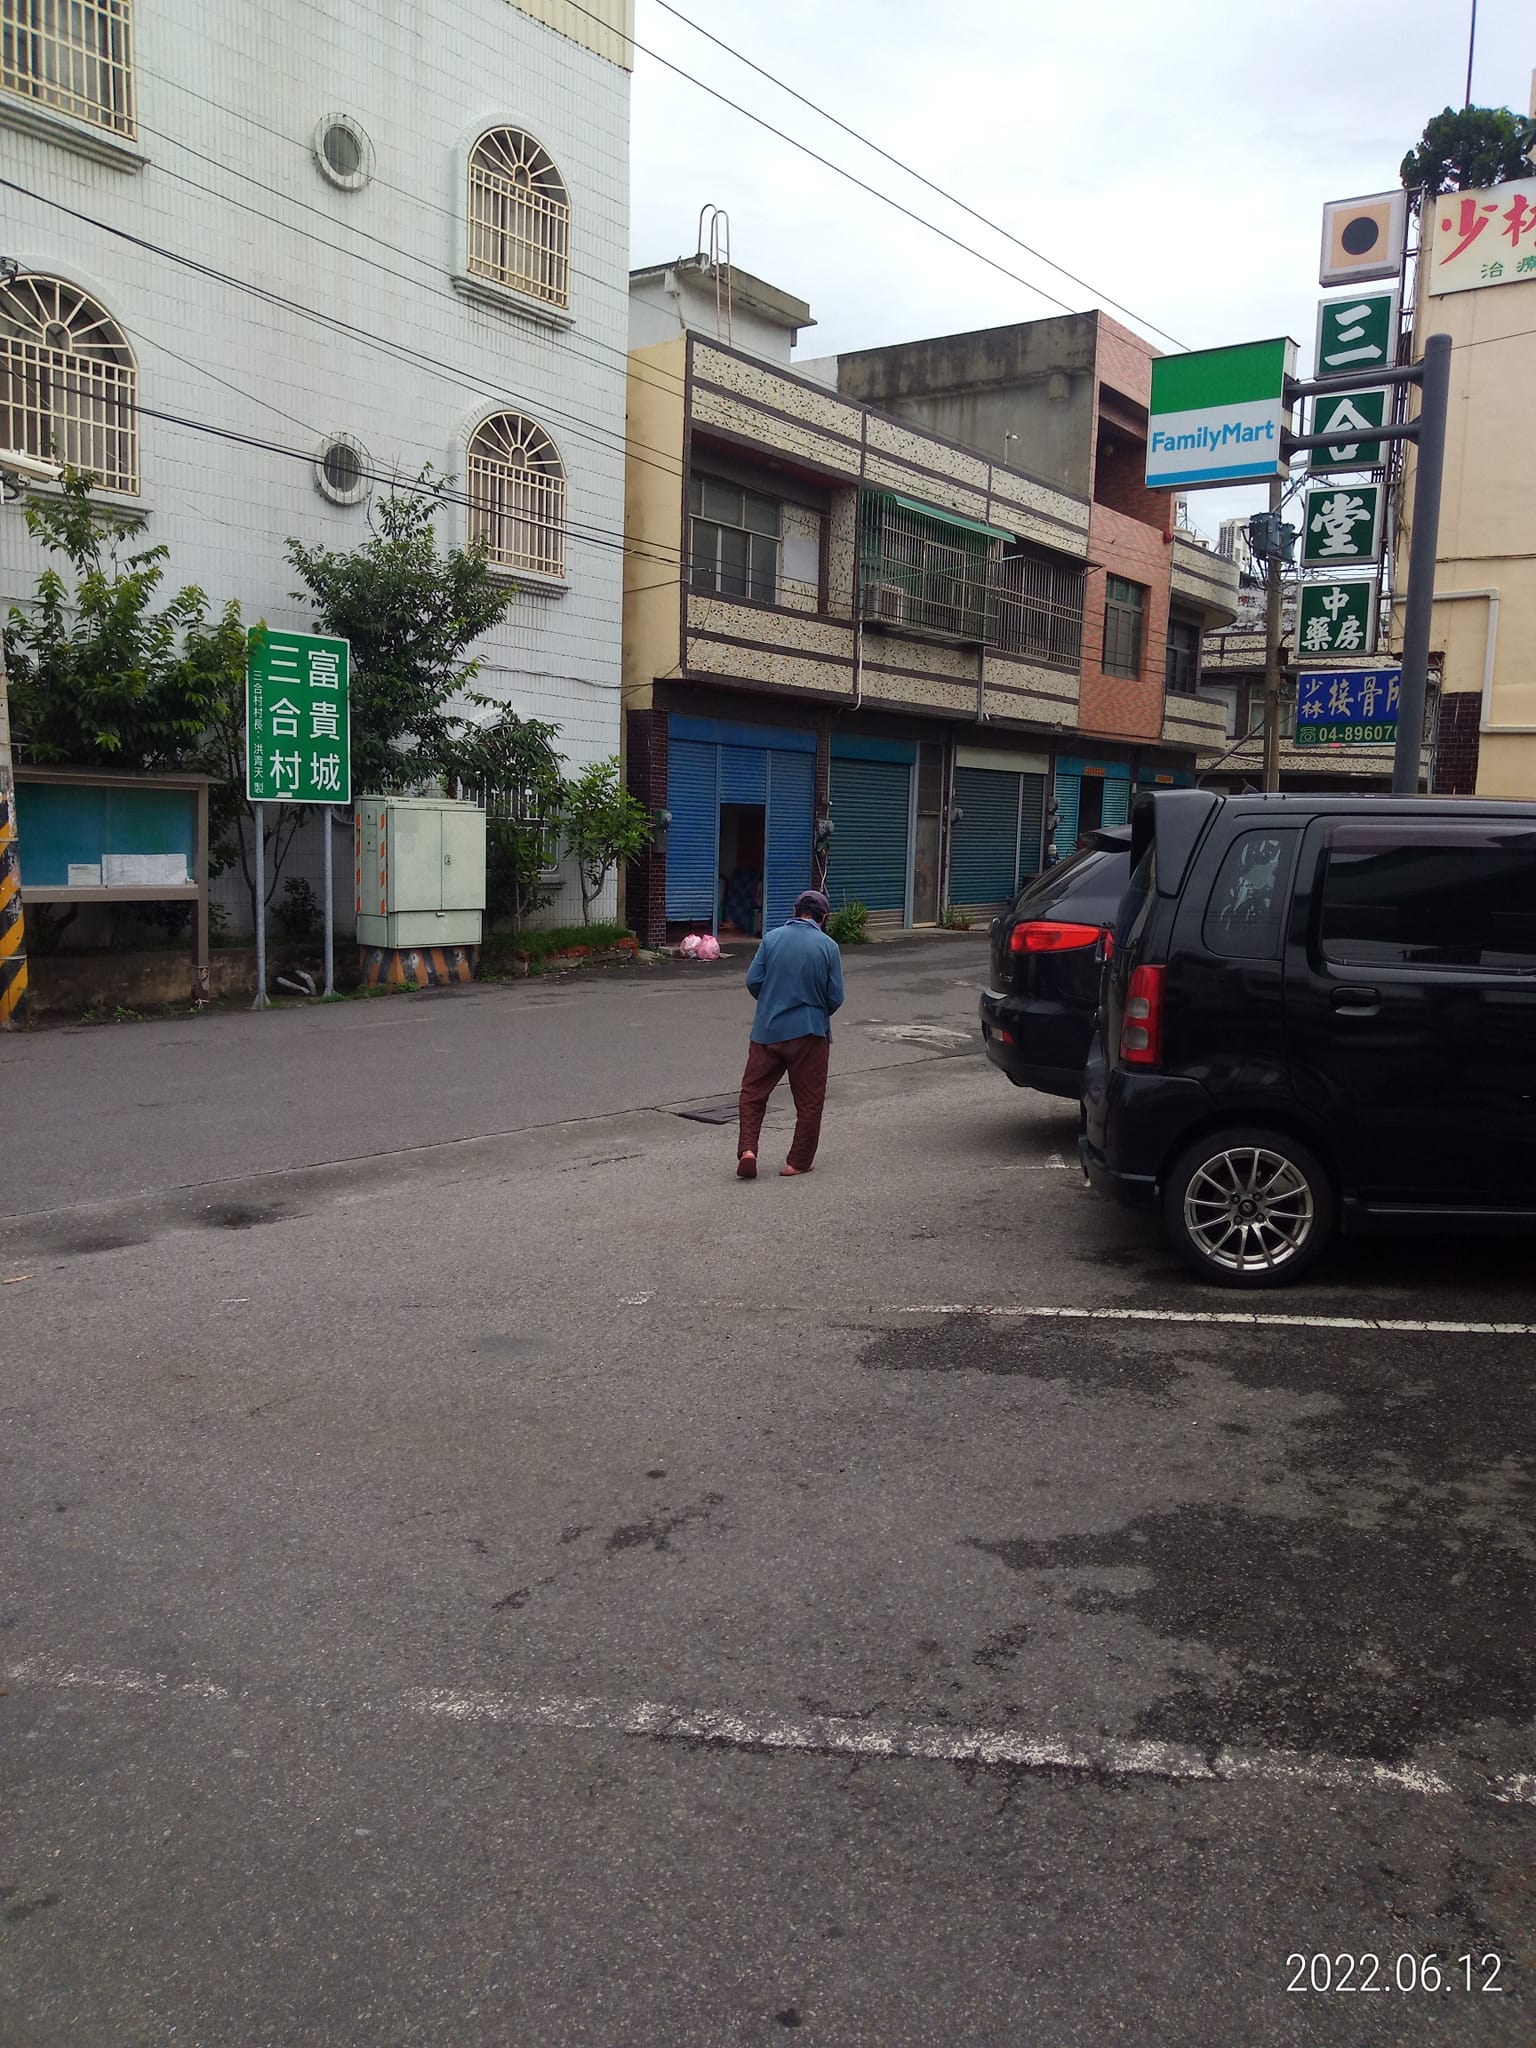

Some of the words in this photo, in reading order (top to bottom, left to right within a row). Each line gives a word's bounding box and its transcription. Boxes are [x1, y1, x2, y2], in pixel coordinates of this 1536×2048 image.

[1151, 420, 1275, 453] FamilyMart
[267, 644, 302, 790] 三合村
[307, 649, 341, 792] 富貴城
